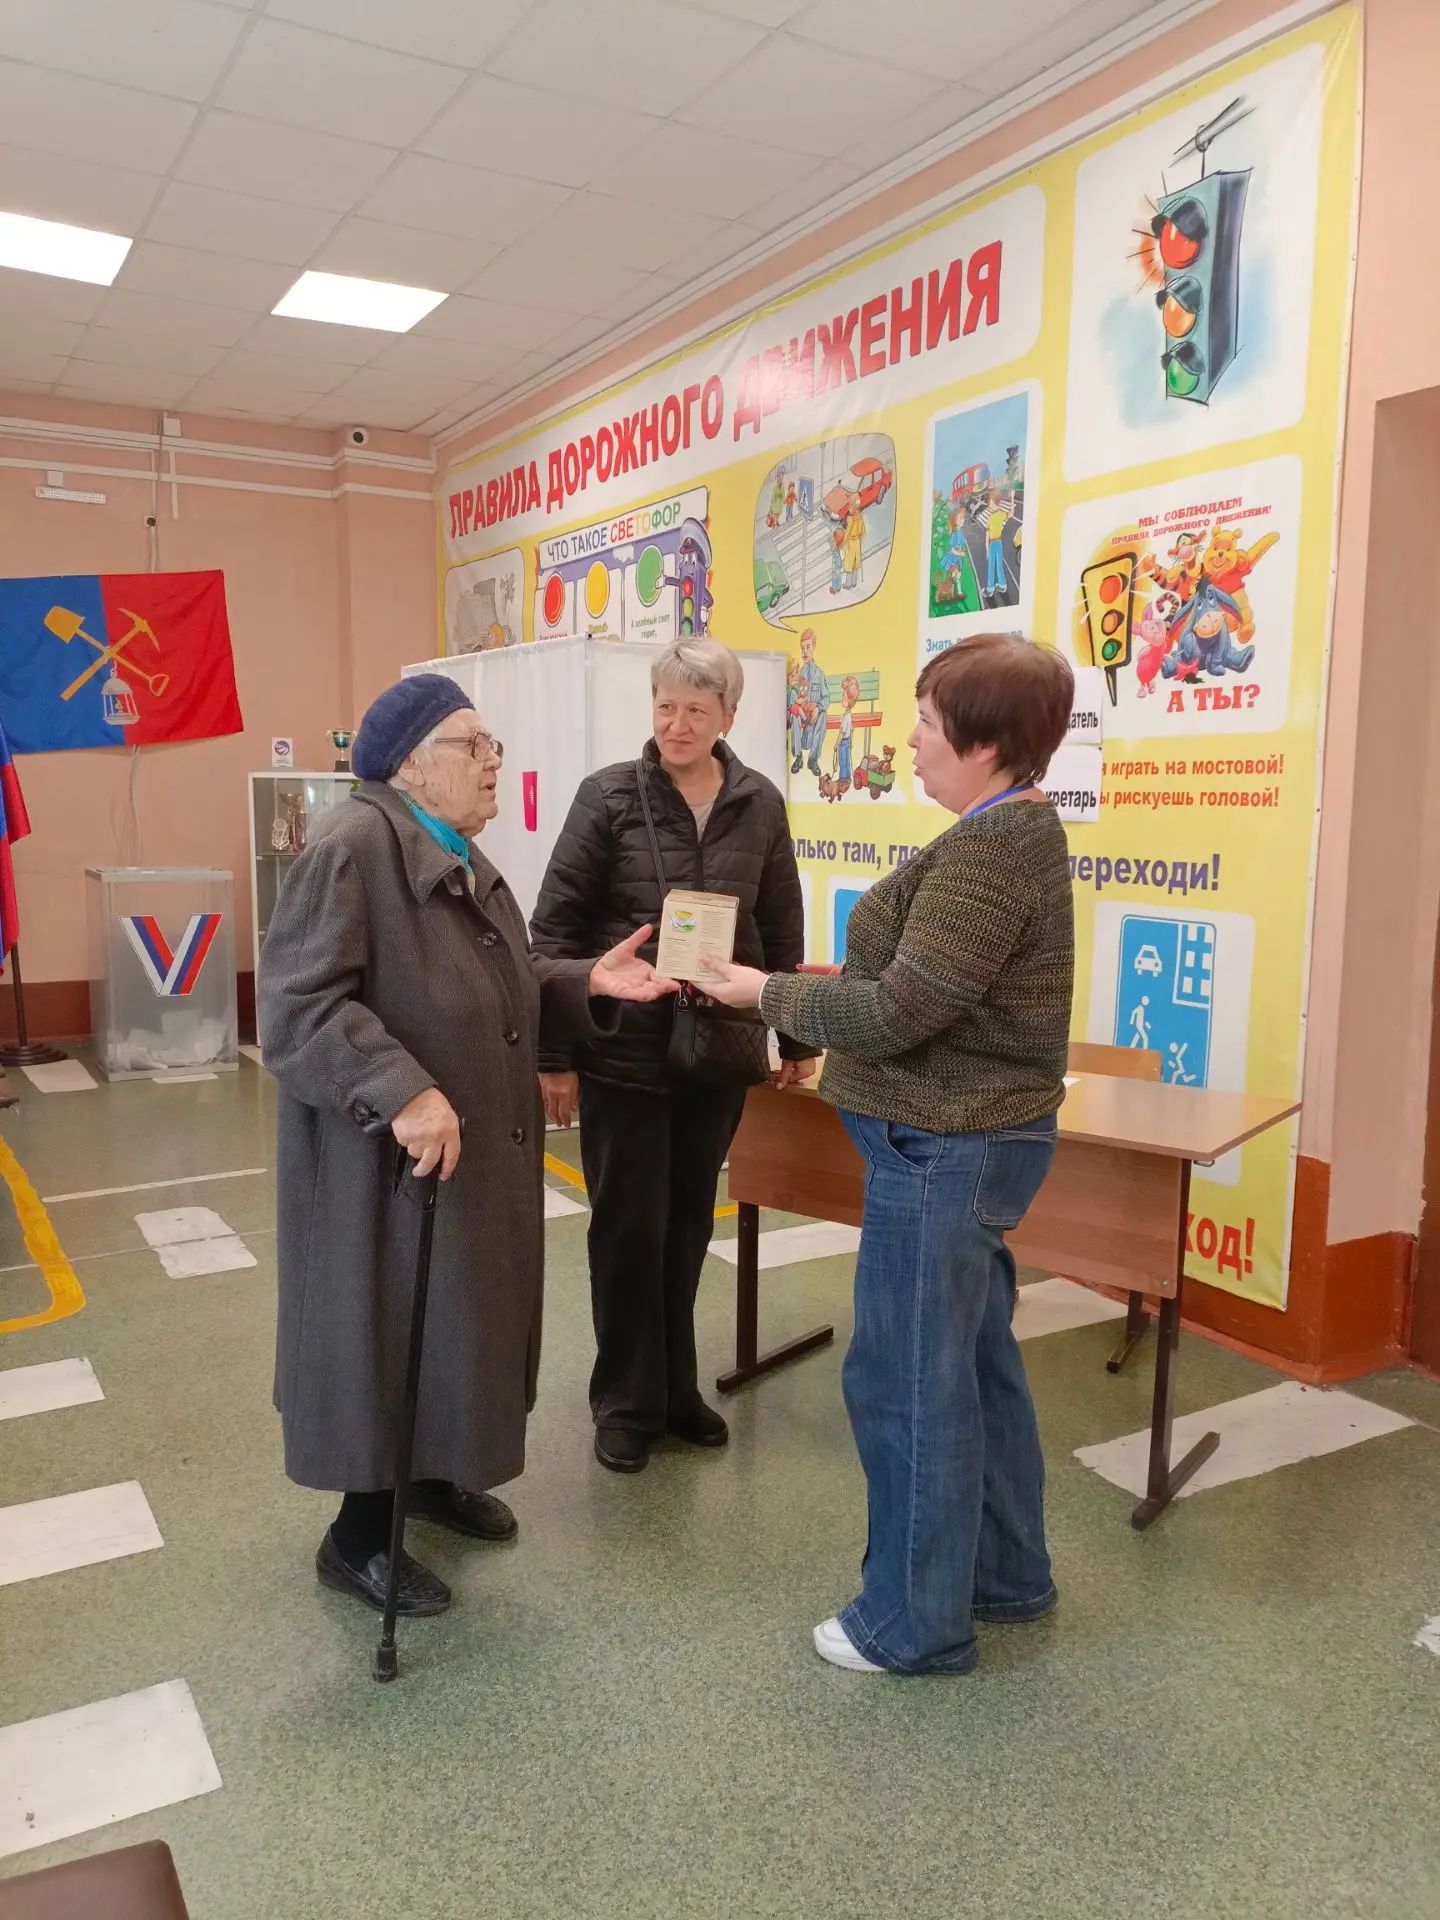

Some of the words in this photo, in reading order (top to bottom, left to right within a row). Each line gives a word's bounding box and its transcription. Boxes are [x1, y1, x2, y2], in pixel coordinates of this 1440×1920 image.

[448, 460, 541, 539] ПРАВИЛА
[546, 374, 724, 514] ДОРОЖНОГО
[733, 239, 1003, 443] ДВИЖЕНИЯ
[1138, 514, 1159, 529] МЫ
[1163, 496, 1243, 522] СОБЛЮДАЕМ
[547, 539, 569, 562] ЧТО
[571, 526, 608, 554] ТАКОЕ
[610, 501, 682, 544] СВЕТОФОР
[1111, 531, 1150, 545] ПРАВИЛА
[1152, 518, 1211, 538] ДОРОЖНОГО
[1166, 690, 1185, 713] А
[1193, 683, 1261, 712] ТЫ?
[1068, 711, 1099, 733] атель
[1111, 760, 1159, 780] играть
[1165, 760, 1187, 776] на
[1192, 753, 1285, 776] мостовой!
[1113, 789, 1194, 810] рискуешь
[1199, 786, 1280, 808] головой!
[842, 841, 882, 871] там,
